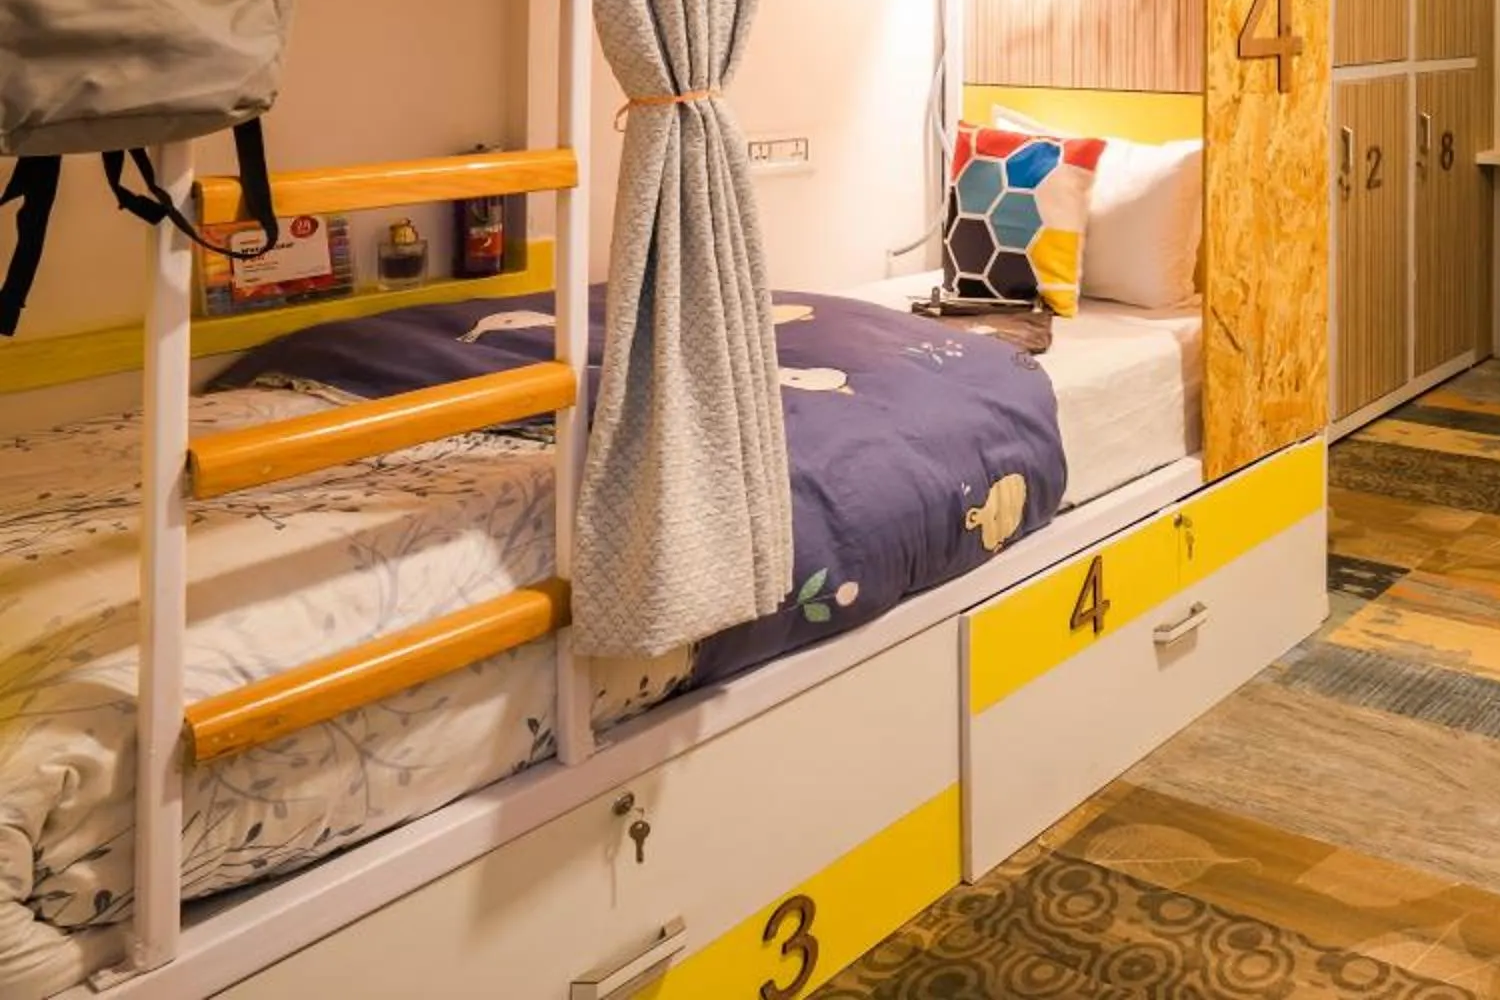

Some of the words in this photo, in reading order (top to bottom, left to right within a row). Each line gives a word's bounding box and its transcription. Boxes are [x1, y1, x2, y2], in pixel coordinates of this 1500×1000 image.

[1366, 146, 1382, 190] 2
[1440, 130, 1454, 171] 8
[1069, 555, 1111, 637] 4
[759, 894, 820, 1000] 3
